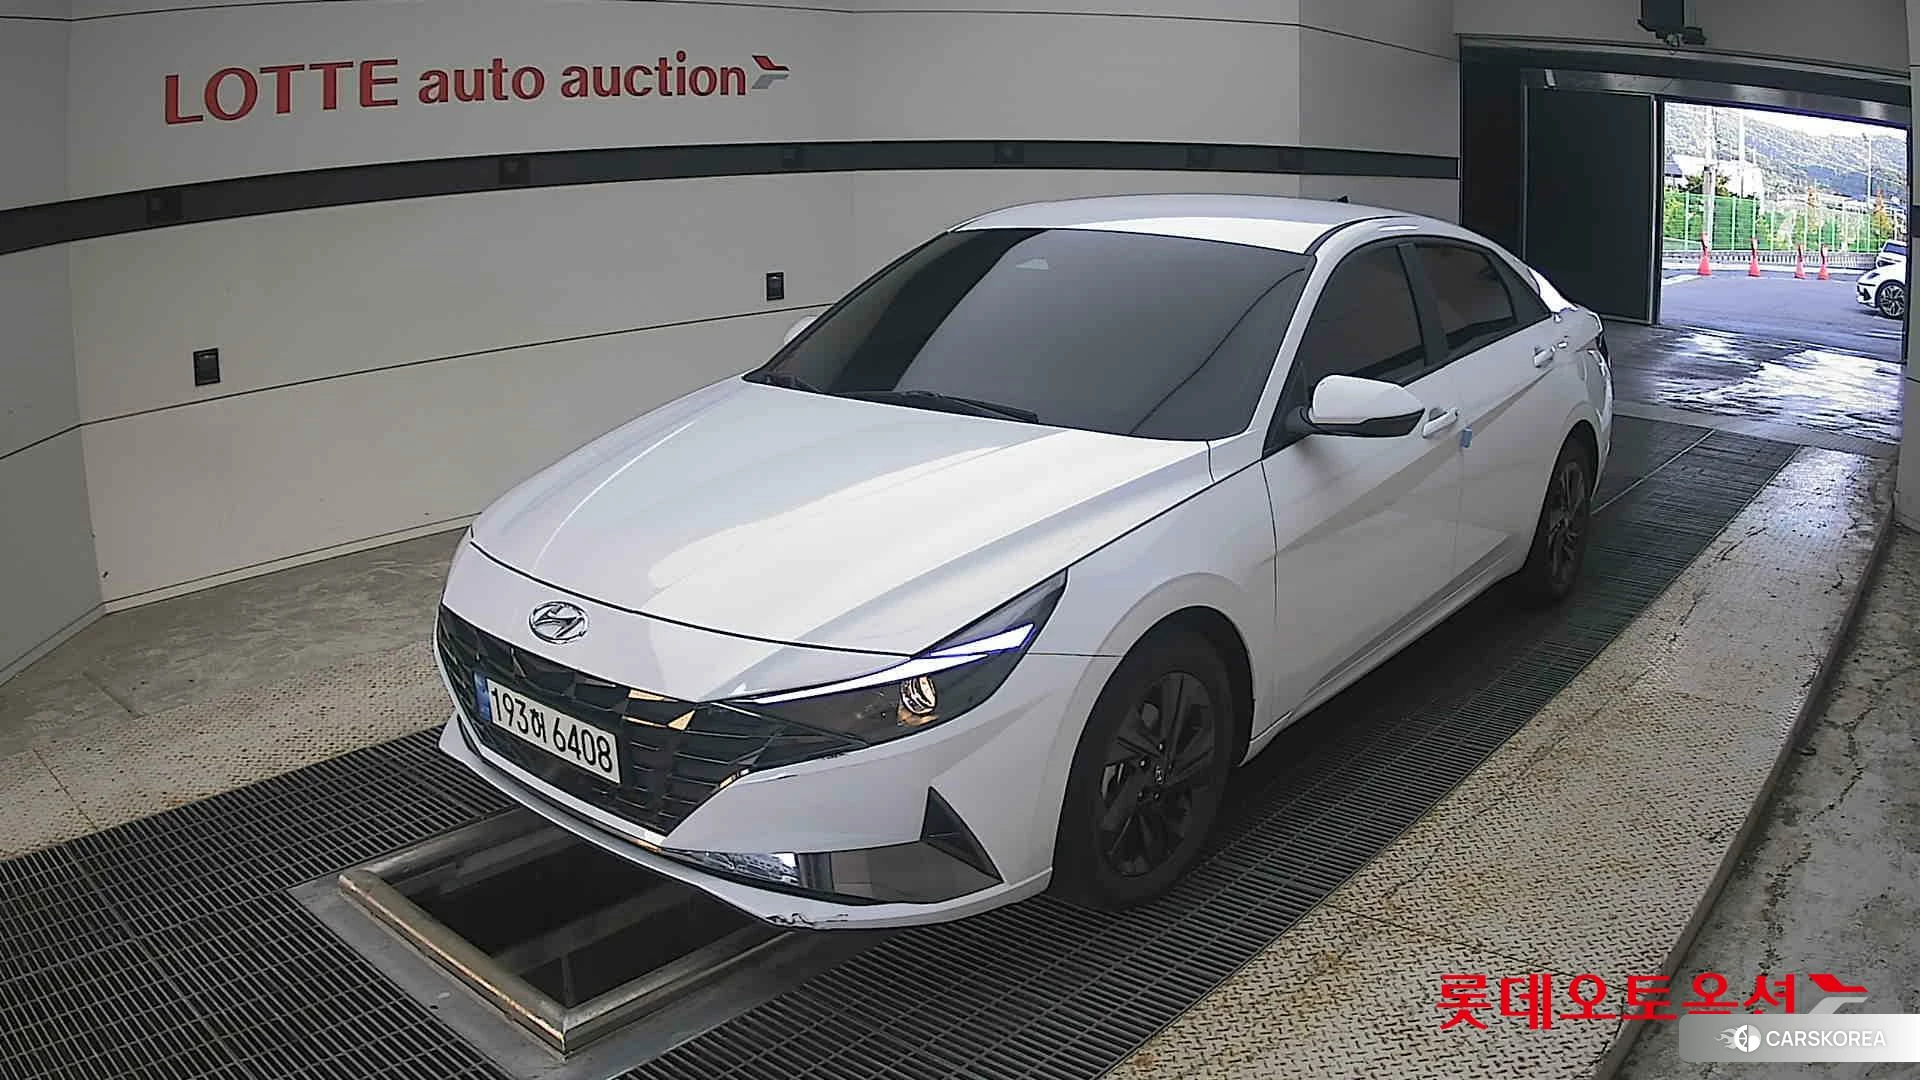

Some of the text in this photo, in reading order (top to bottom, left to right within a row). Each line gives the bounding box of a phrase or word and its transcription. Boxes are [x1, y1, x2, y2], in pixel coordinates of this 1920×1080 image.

[164, 50, 747, 125] LOTTE auto auction
[491, 687, 613, 773] 193허 6408
